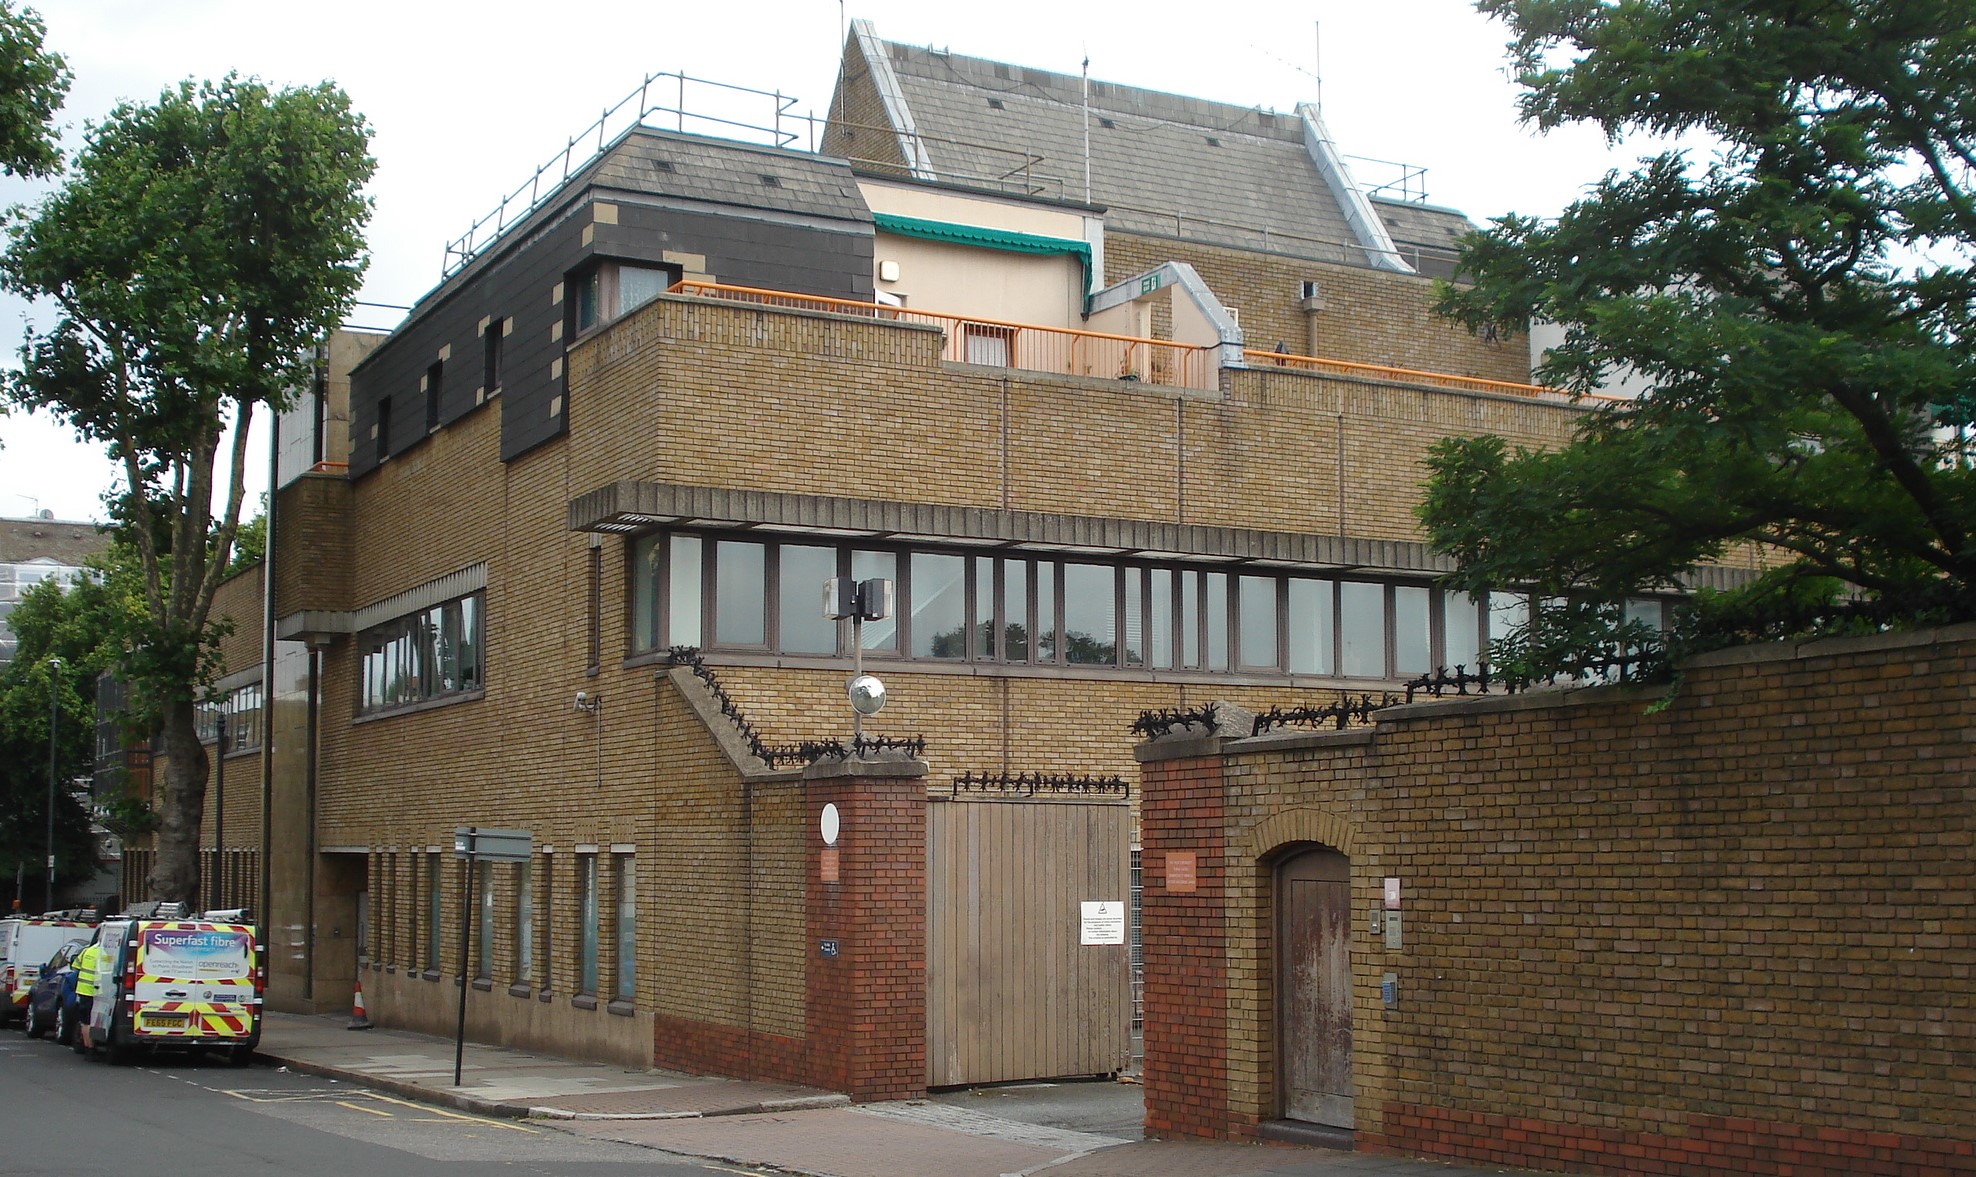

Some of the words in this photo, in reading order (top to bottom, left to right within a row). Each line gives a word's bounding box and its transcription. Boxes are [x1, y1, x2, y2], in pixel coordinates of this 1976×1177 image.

[154, 933, 208, 946] Superfast
[211, 936, 236, 947] fibre
[198, 961, 238, 969] openreach
